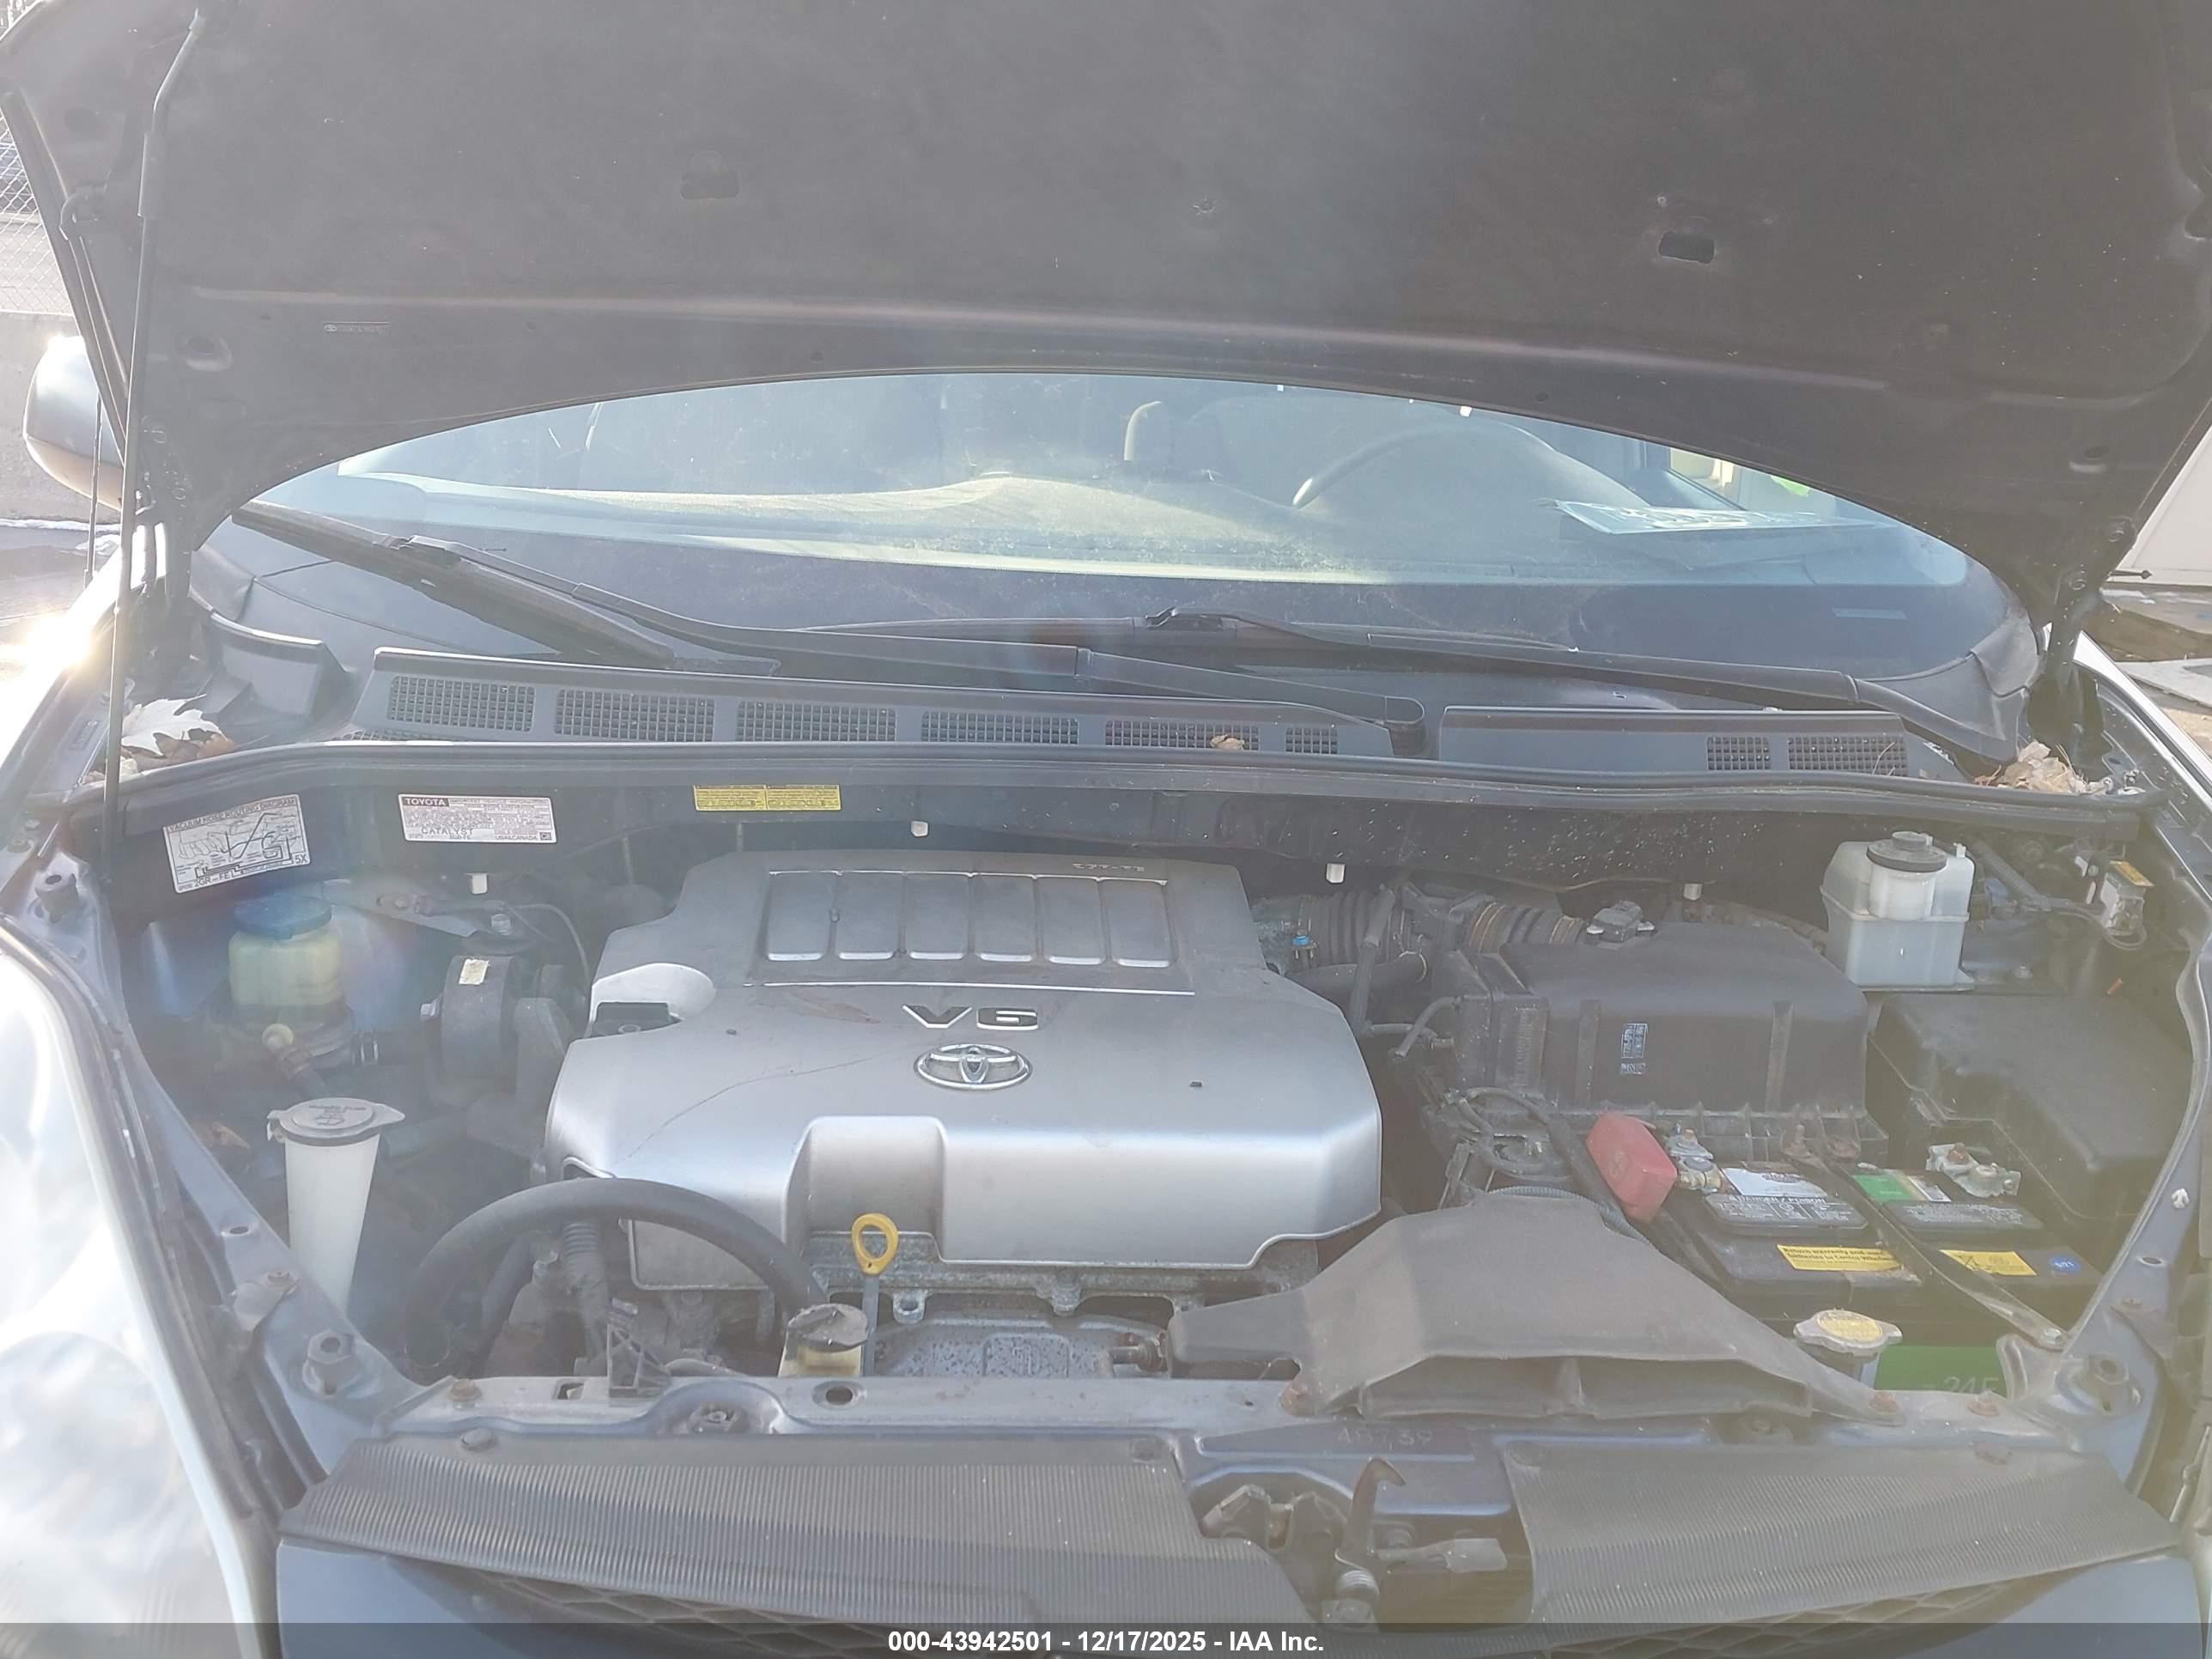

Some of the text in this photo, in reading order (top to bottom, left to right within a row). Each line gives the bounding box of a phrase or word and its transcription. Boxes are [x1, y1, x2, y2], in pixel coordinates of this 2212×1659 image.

[405, 798, 447, 806] TOYOTA
[295, 853, 309, 865] 5X
[902, 1005, 1039, 1031] V6
